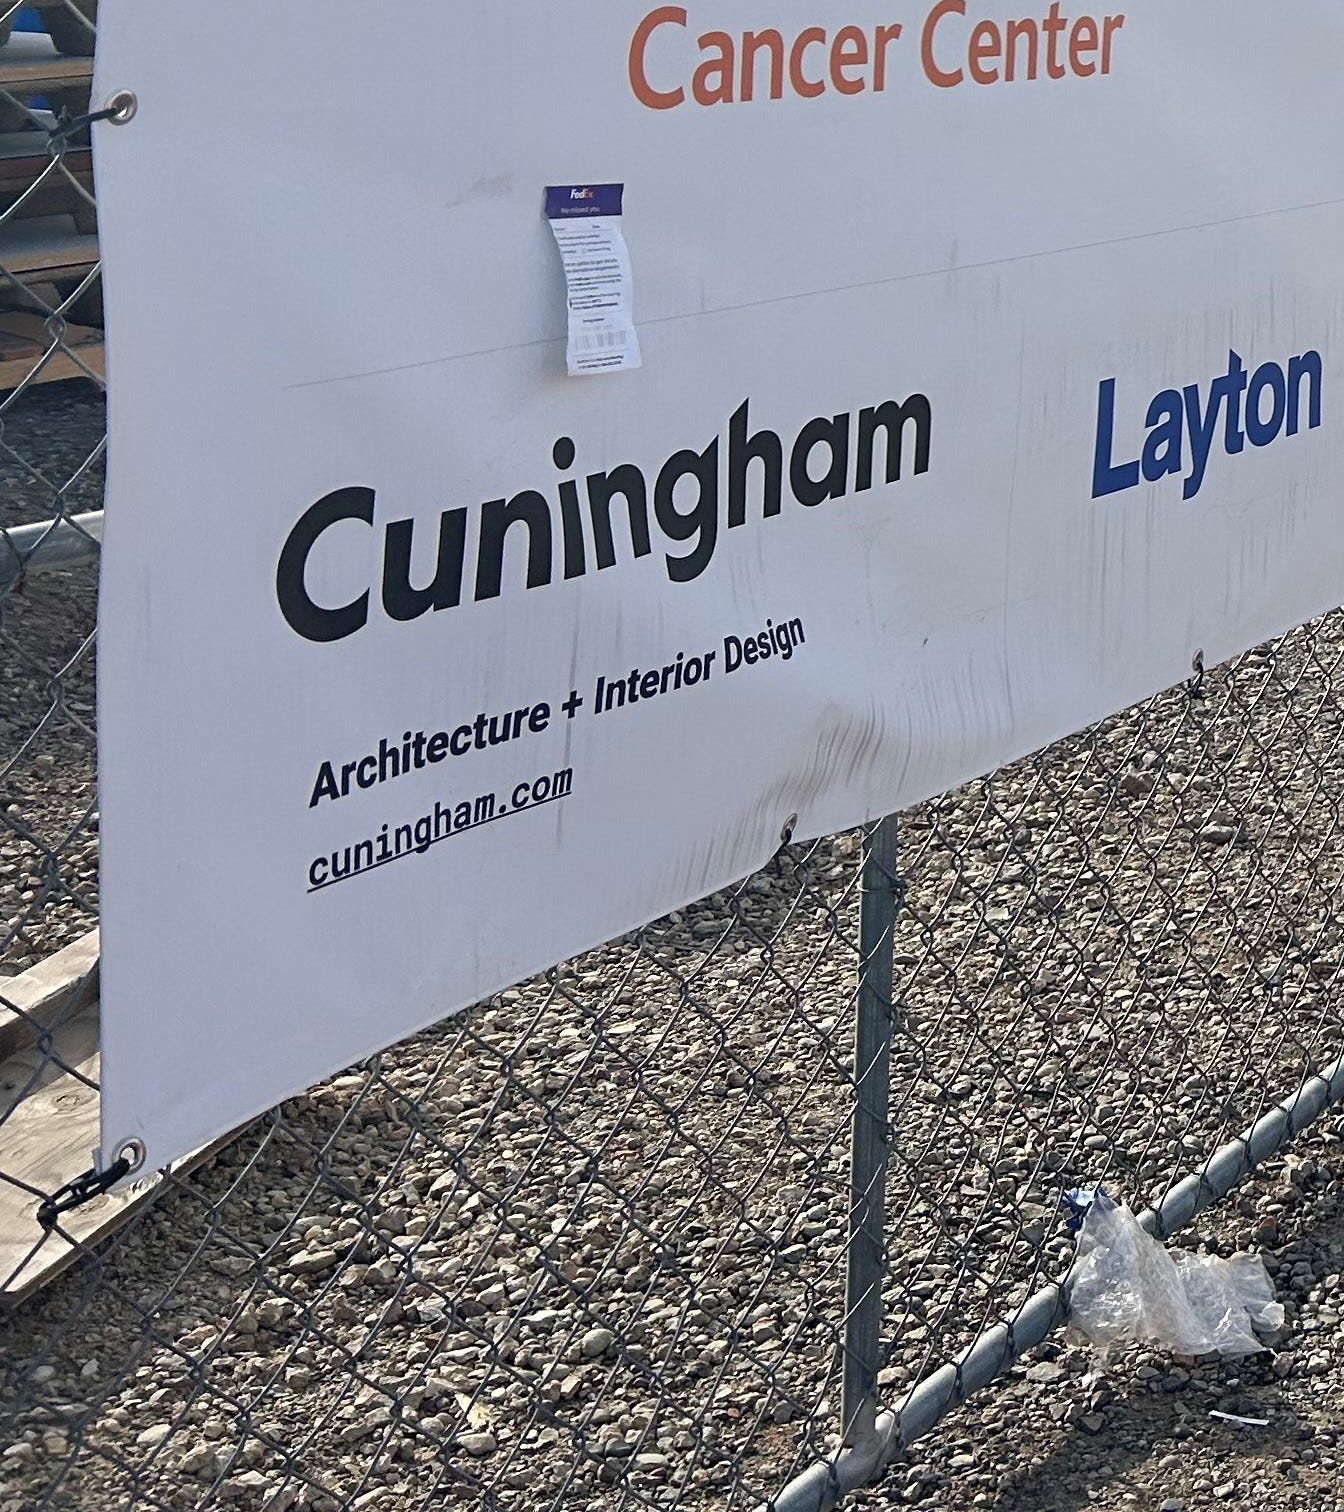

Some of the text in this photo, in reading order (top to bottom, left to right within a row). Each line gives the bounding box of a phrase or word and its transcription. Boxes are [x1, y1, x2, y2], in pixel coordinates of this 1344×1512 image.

[628, 6, 902, 110] Cancer
[570, 188, 594, 199] FedEx
[1091, 349, 1322, 500] Layton
[276, 394, 931, 642] Cuningham
[308, 618, 806, 808] Architecture + Interior Design
[306, 768, 573, 887] cuningham.com
